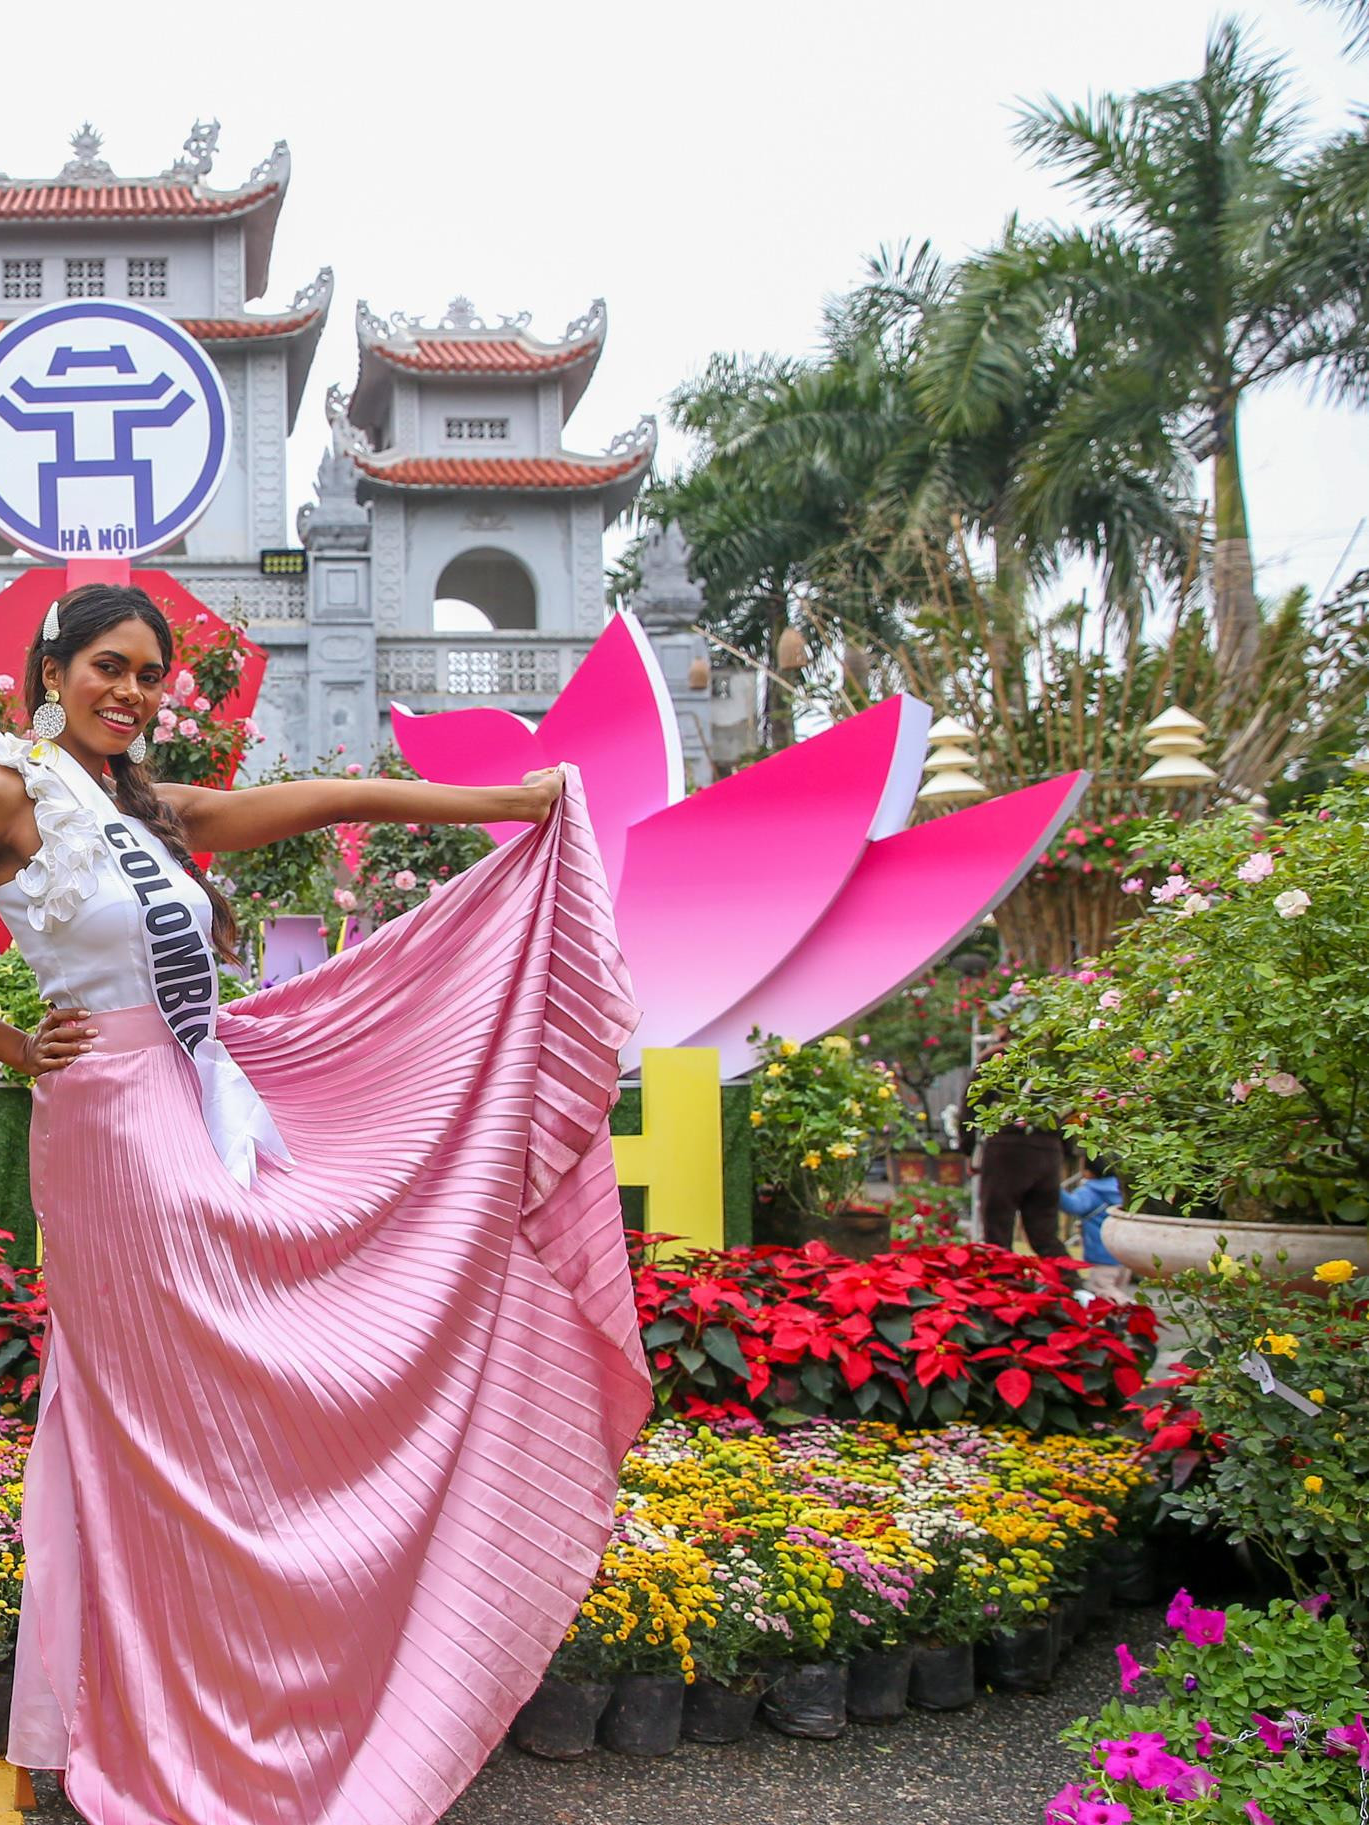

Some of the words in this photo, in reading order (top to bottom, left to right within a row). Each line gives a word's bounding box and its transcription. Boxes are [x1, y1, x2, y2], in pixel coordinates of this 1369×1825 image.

[60, 524, 92, 551] HÀ
[98, 523, 135, 555] NỘI
[104, 822, 213, 1060] COLOMBIA
